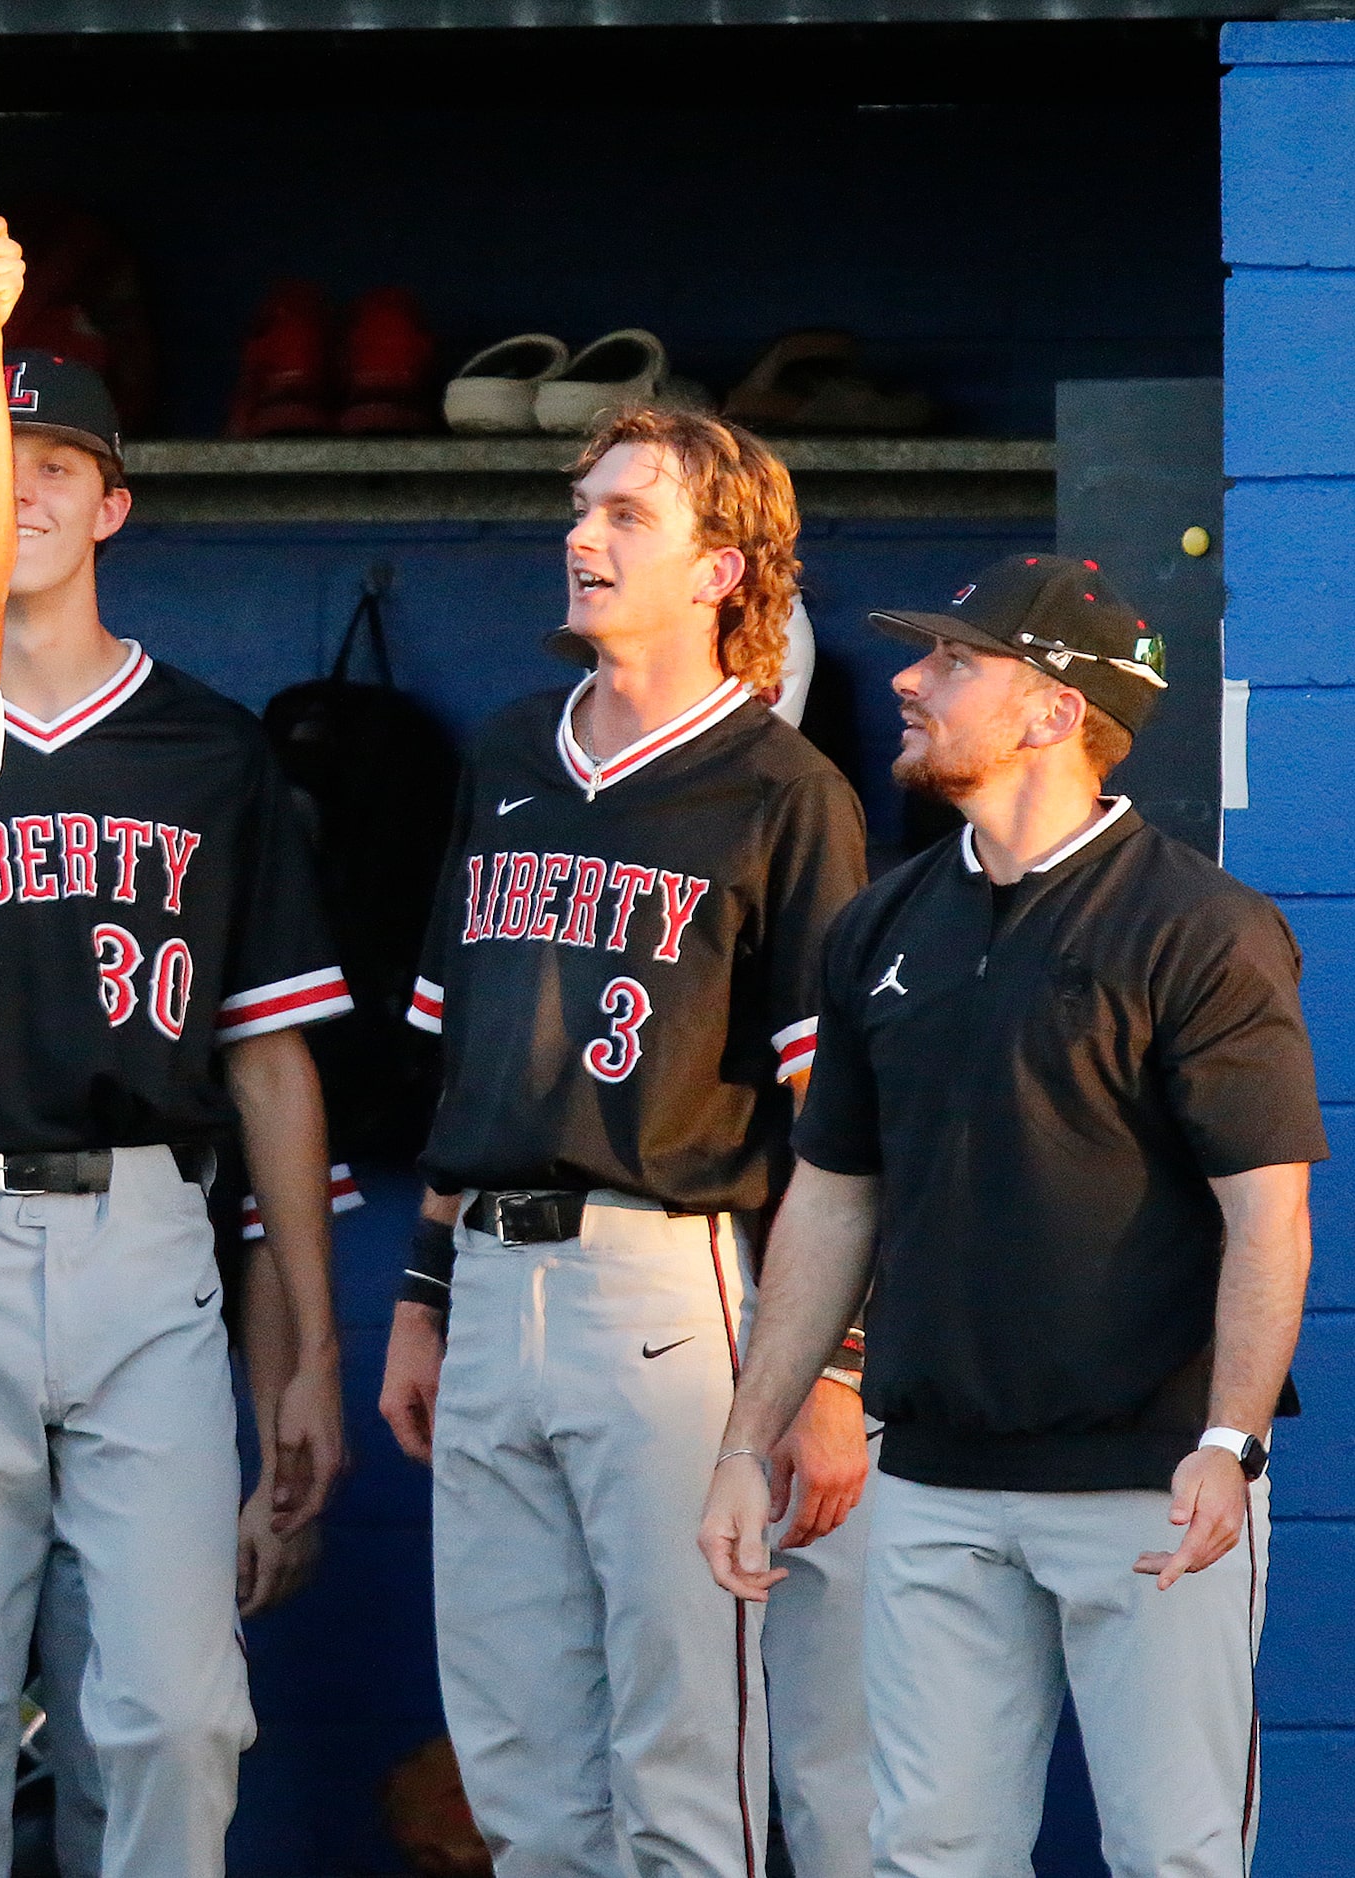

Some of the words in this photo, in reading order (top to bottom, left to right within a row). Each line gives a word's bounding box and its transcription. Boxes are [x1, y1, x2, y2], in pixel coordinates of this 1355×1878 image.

[4, 361, 39, 411] L
[462, 851, 711, 964] LIBERTY
[92, 922, 194, 1041] 30
[582, 976, 654, 1084] 3
